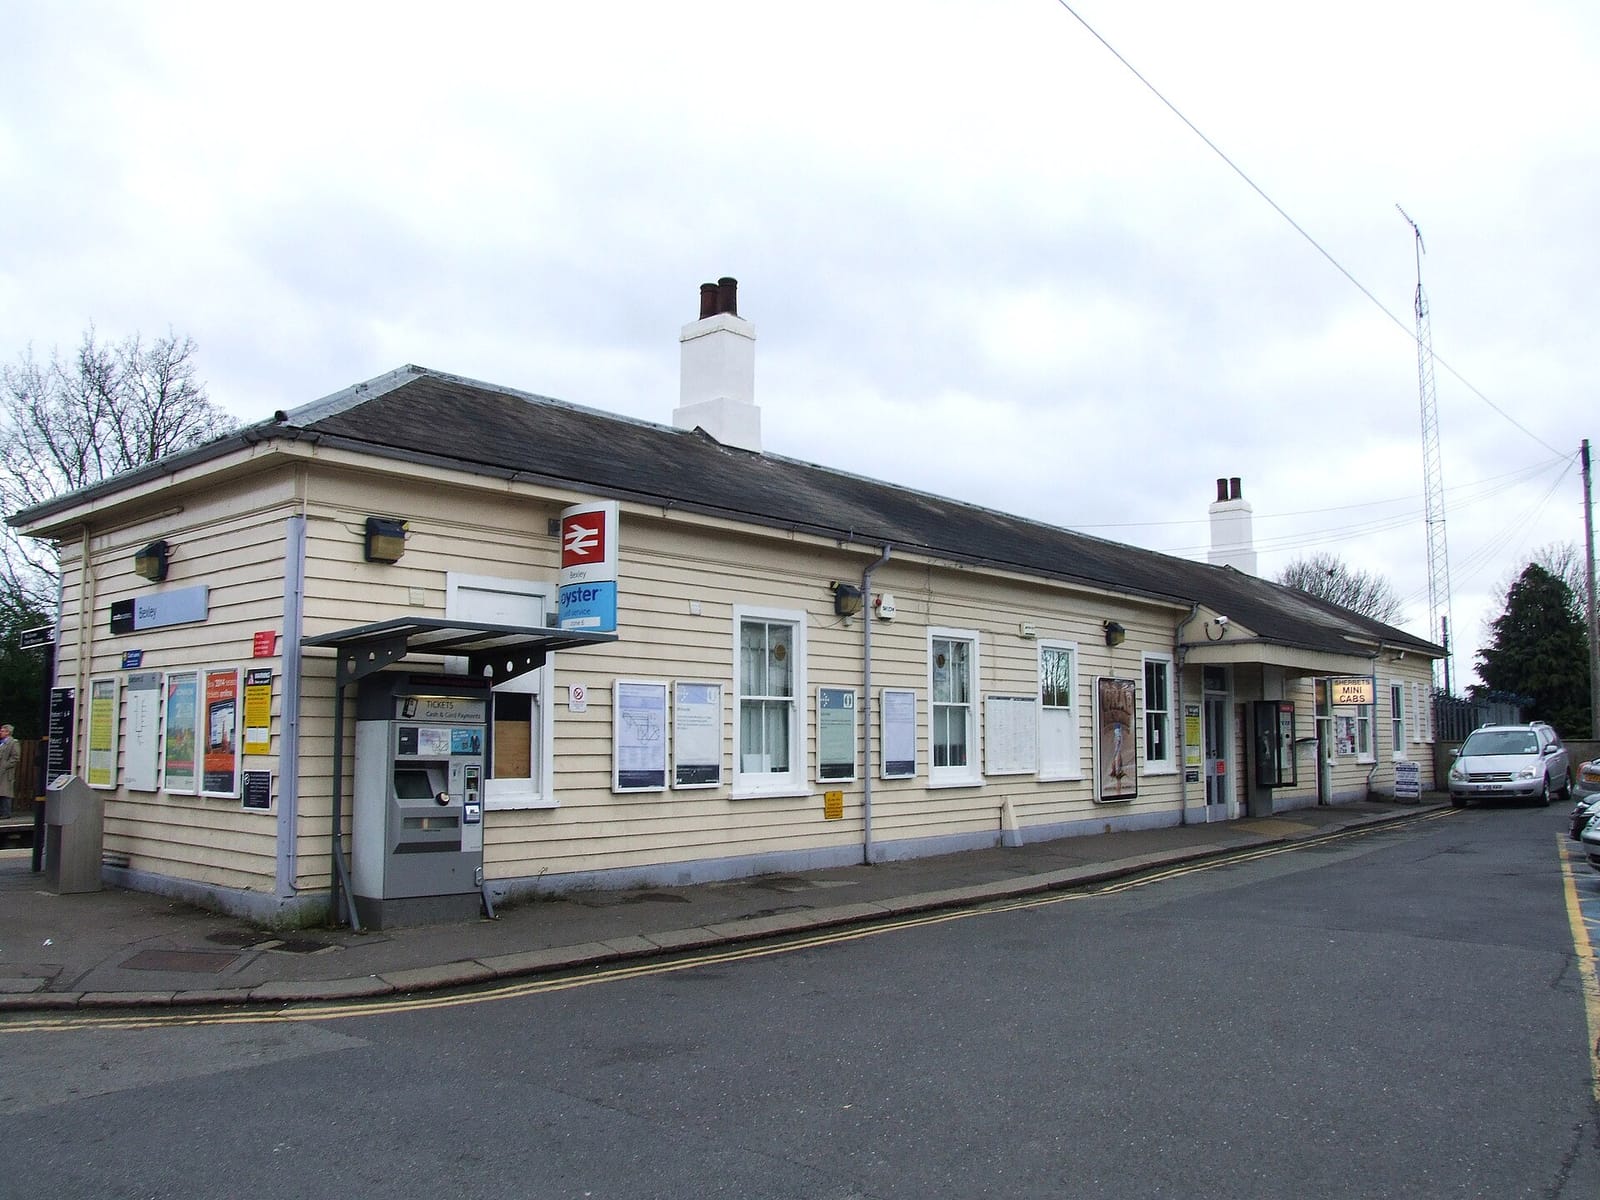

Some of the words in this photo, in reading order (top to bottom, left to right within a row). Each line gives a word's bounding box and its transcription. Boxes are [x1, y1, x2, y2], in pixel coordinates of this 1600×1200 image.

[569, 570, 587, 579] Bexley
[560, 586, 598, 607] oyster
[138, 605, 157, 620] Bexley
[1342, 686, 1362, 694] MINI
[1339, 694, 1366, 703] CABS
[427, 700, 454, 709] TICKETS
[458, 712, 481, 720] Payments
